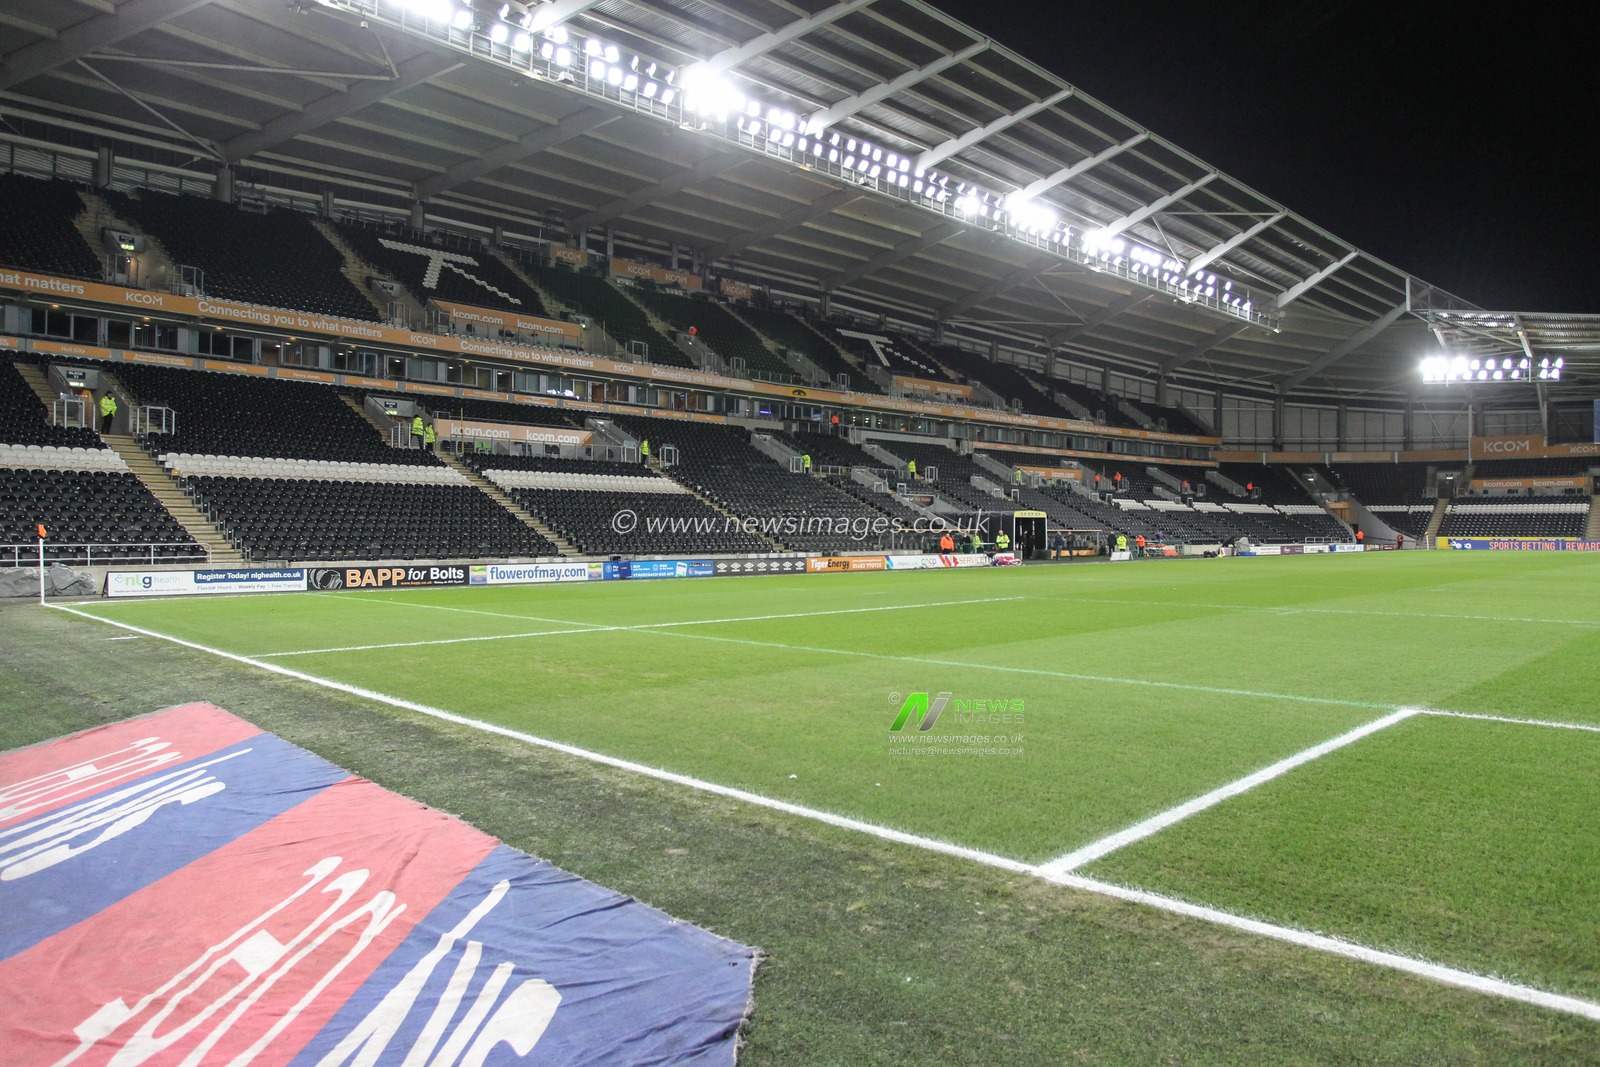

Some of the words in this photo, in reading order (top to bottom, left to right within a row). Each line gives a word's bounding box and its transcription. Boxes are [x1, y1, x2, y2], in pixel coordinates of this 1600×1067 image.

[557, 249, 582, 262] KCOM
[627, 265, 651, 277] KCOM
[665, 272, 688, 285] KCOM
[24, 277, 85, 294] matters
[726, 285, 747, 295] KCOM
[125, 292, 163, 306] KCOM
[197, 301, 271, 324] Connecting
[273, 315, 295, 329] you
[297, 317, 309, 327] to
[312, 319, 340, 332] what
[341, 324, 382, 338] matters
[453, 308, 503, 325] kcom.com
[517, 319, 564, 334] kcom.com
[410, 333, 436, 346] KCOM
[460, 340, 512, 358] Connecting
[514, 350, 530, 360] you
[531, 352, 540, 360] to
[541, 353, 562, 364] what
[563, 357, 594, 368] matters
[613, 362, 634, 374] KCOM
[651, 368, 692, 383] Connecting
[692, 375, 705, 385] you
[706, 376, 714, 384] to
[451, 423, 510, 438] kcom.com
[526, 429, 580, 443] kcom.com
[1483, 440, 1529, 453] KCOM
[1489, 541, 1519, 550] SPORTS
[1521, 541, 1556, 550] BETTING
[153, 575, 180, 584] health
[197, 572, 226, 581] Register
[226, 572, 250, 580] Today!
[250, 571, 302, 580] nlghealth.co.uk
[346, 568, 406, 587] BAPP
[408, 568, 427, 580] for
[430, 567, 464, 580] Bolts
[490, 566, 586, 581] flowerofmay.com
[125, 574, 152, 588] nlg
